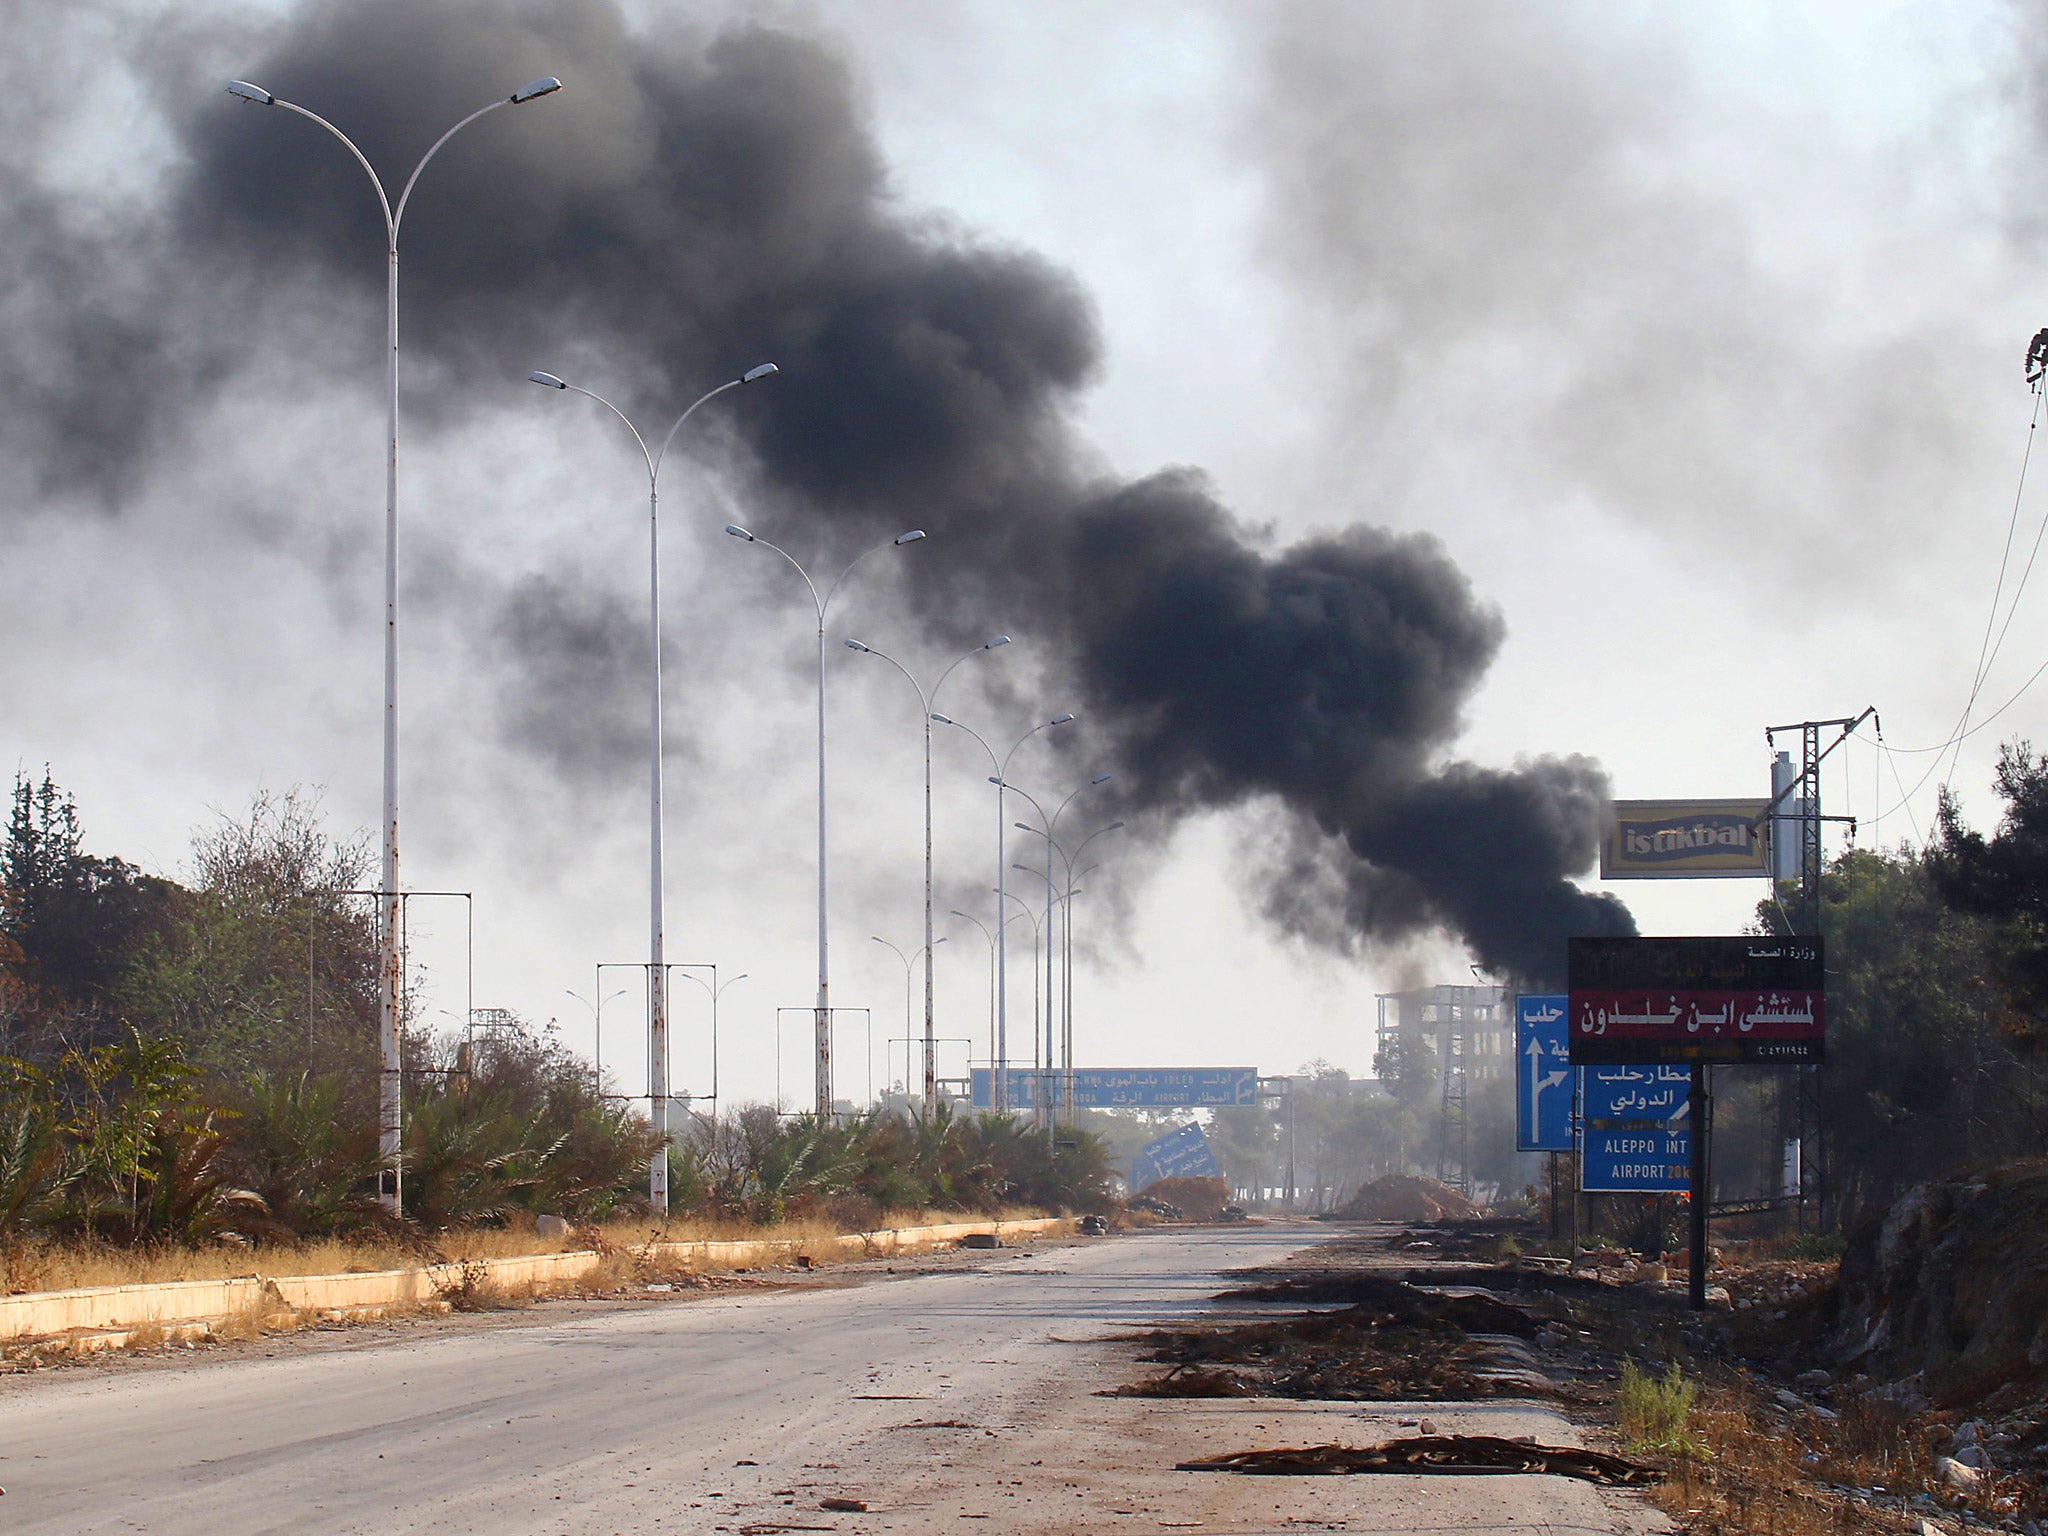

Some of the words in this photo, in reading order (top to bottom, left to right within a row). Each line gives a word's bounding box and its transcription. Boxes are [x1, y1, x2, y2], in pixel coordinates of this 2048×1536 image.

[1626, 821, 1748, 855] istikbal
[1747, 946, 1786, 958] الصحة
[1790, 947, 1816, 960] وزارة
[1523, 1003, 1564, 1028] حلب
[1580, 995, 1684, 1035] خلدون
[1687, 998, 1735, 1034] ابن
[1154, 1092, 1190, 1103] AIRPORT
[1609, 1089, 1674, 1115] الدولي
[1604, 1139, 1655, 1154] ALEPPO
[1612, 1164, 1666, 1179] AIRPORT
